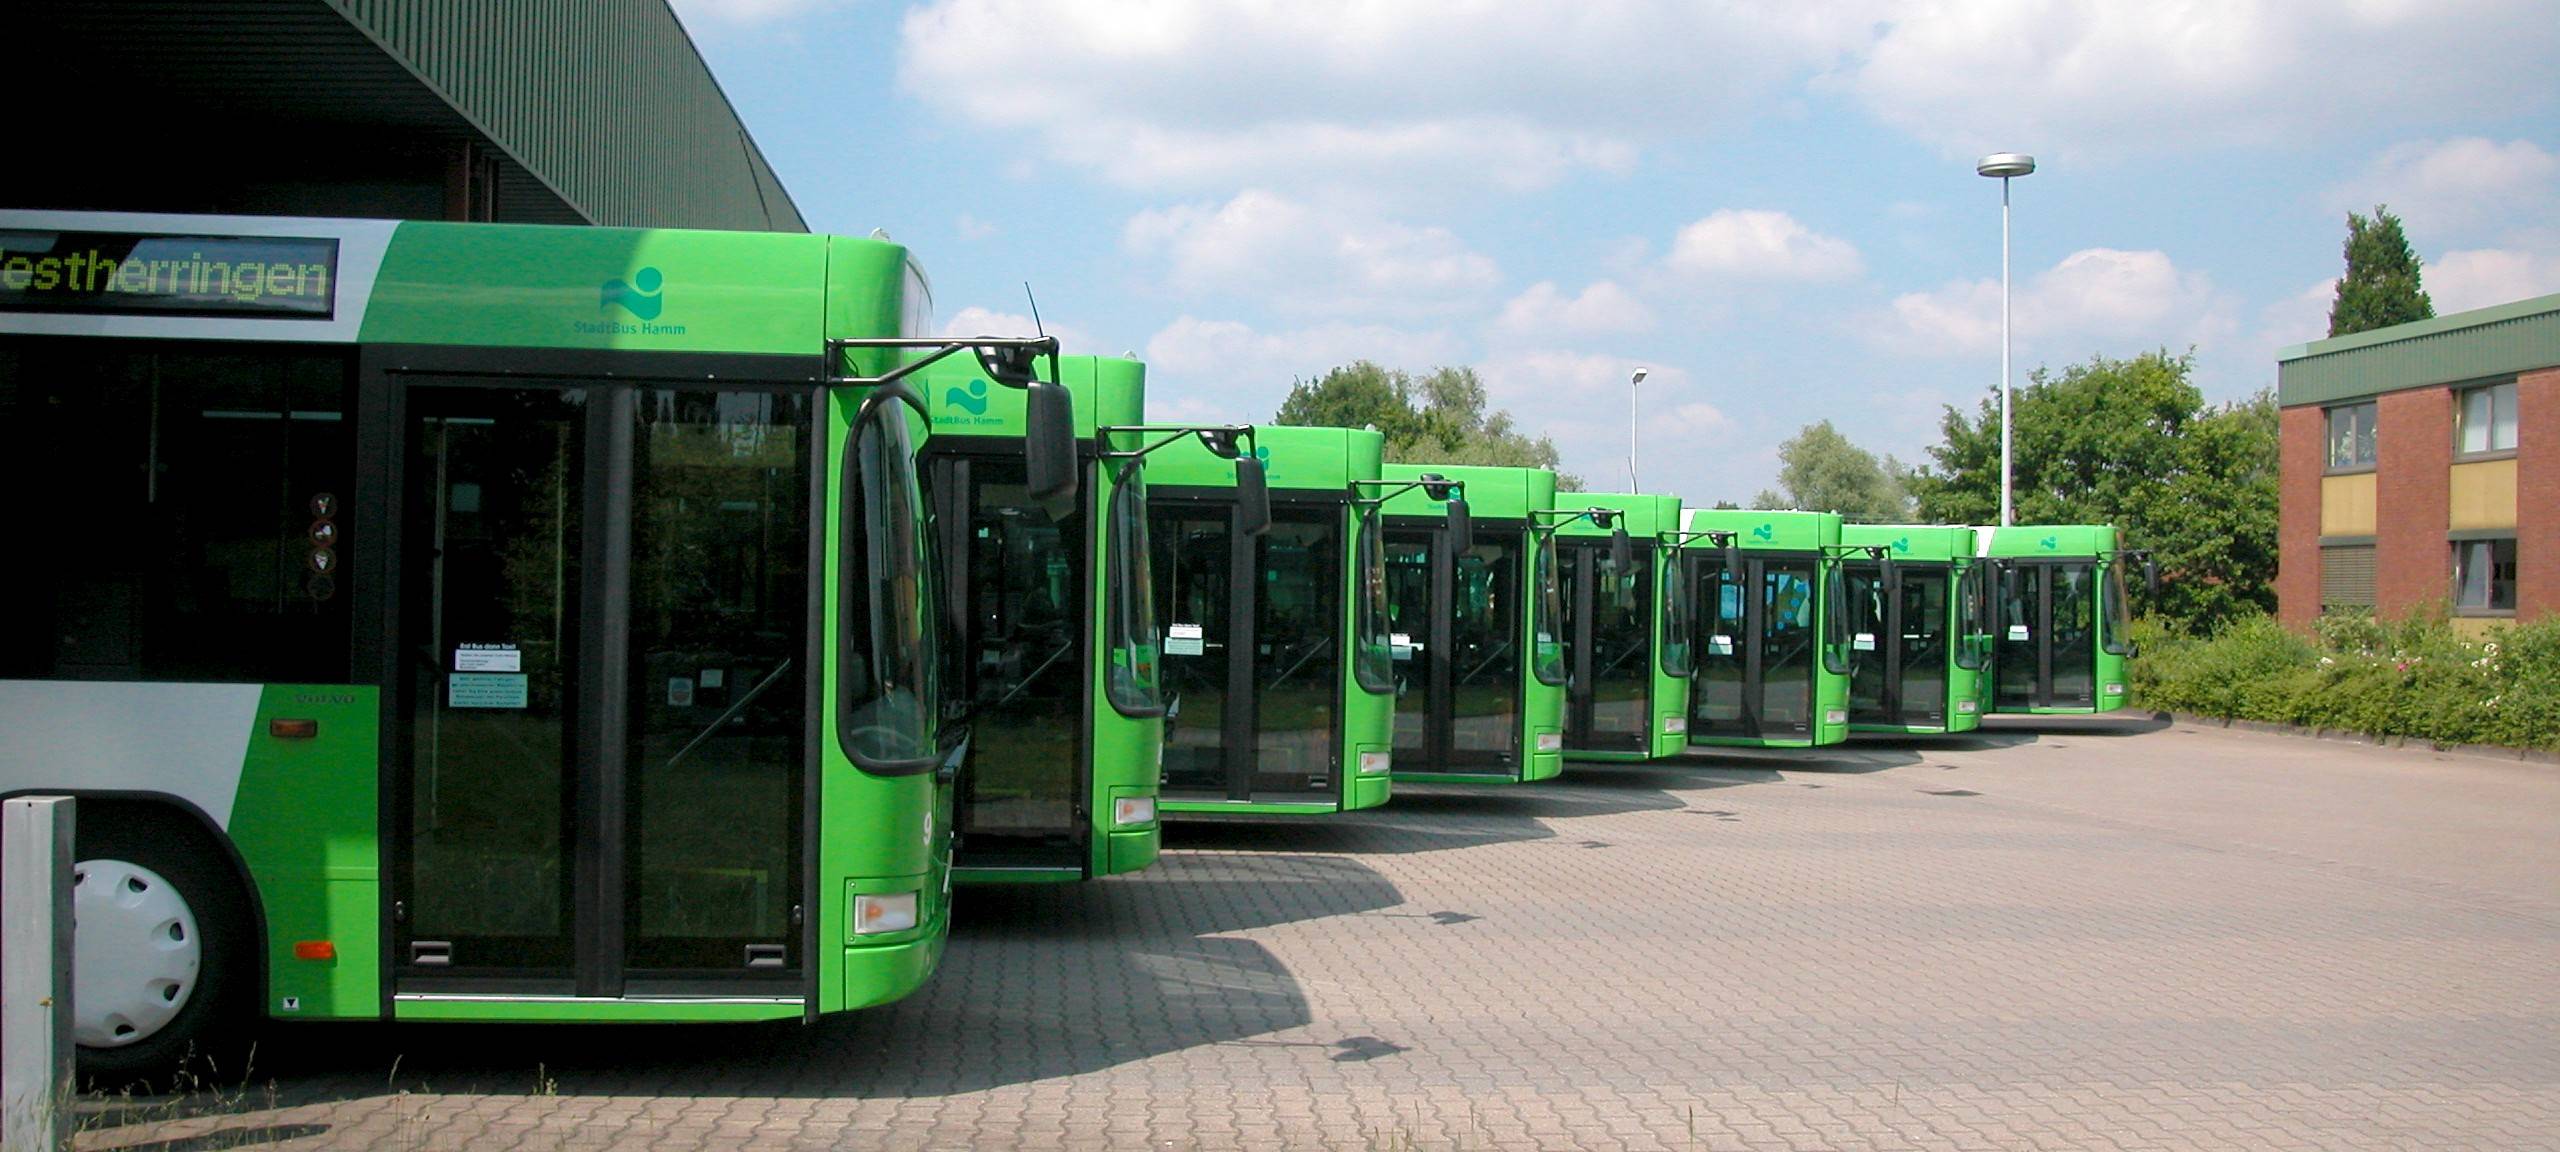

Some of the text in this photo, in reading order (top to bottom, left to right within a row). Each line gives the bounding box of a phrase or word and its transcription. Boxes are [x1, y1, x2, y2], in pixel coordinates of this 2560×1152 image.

[0, 248, 328, 301] estherringen
[574, 321, 686, 335] StadtBus Hamm
